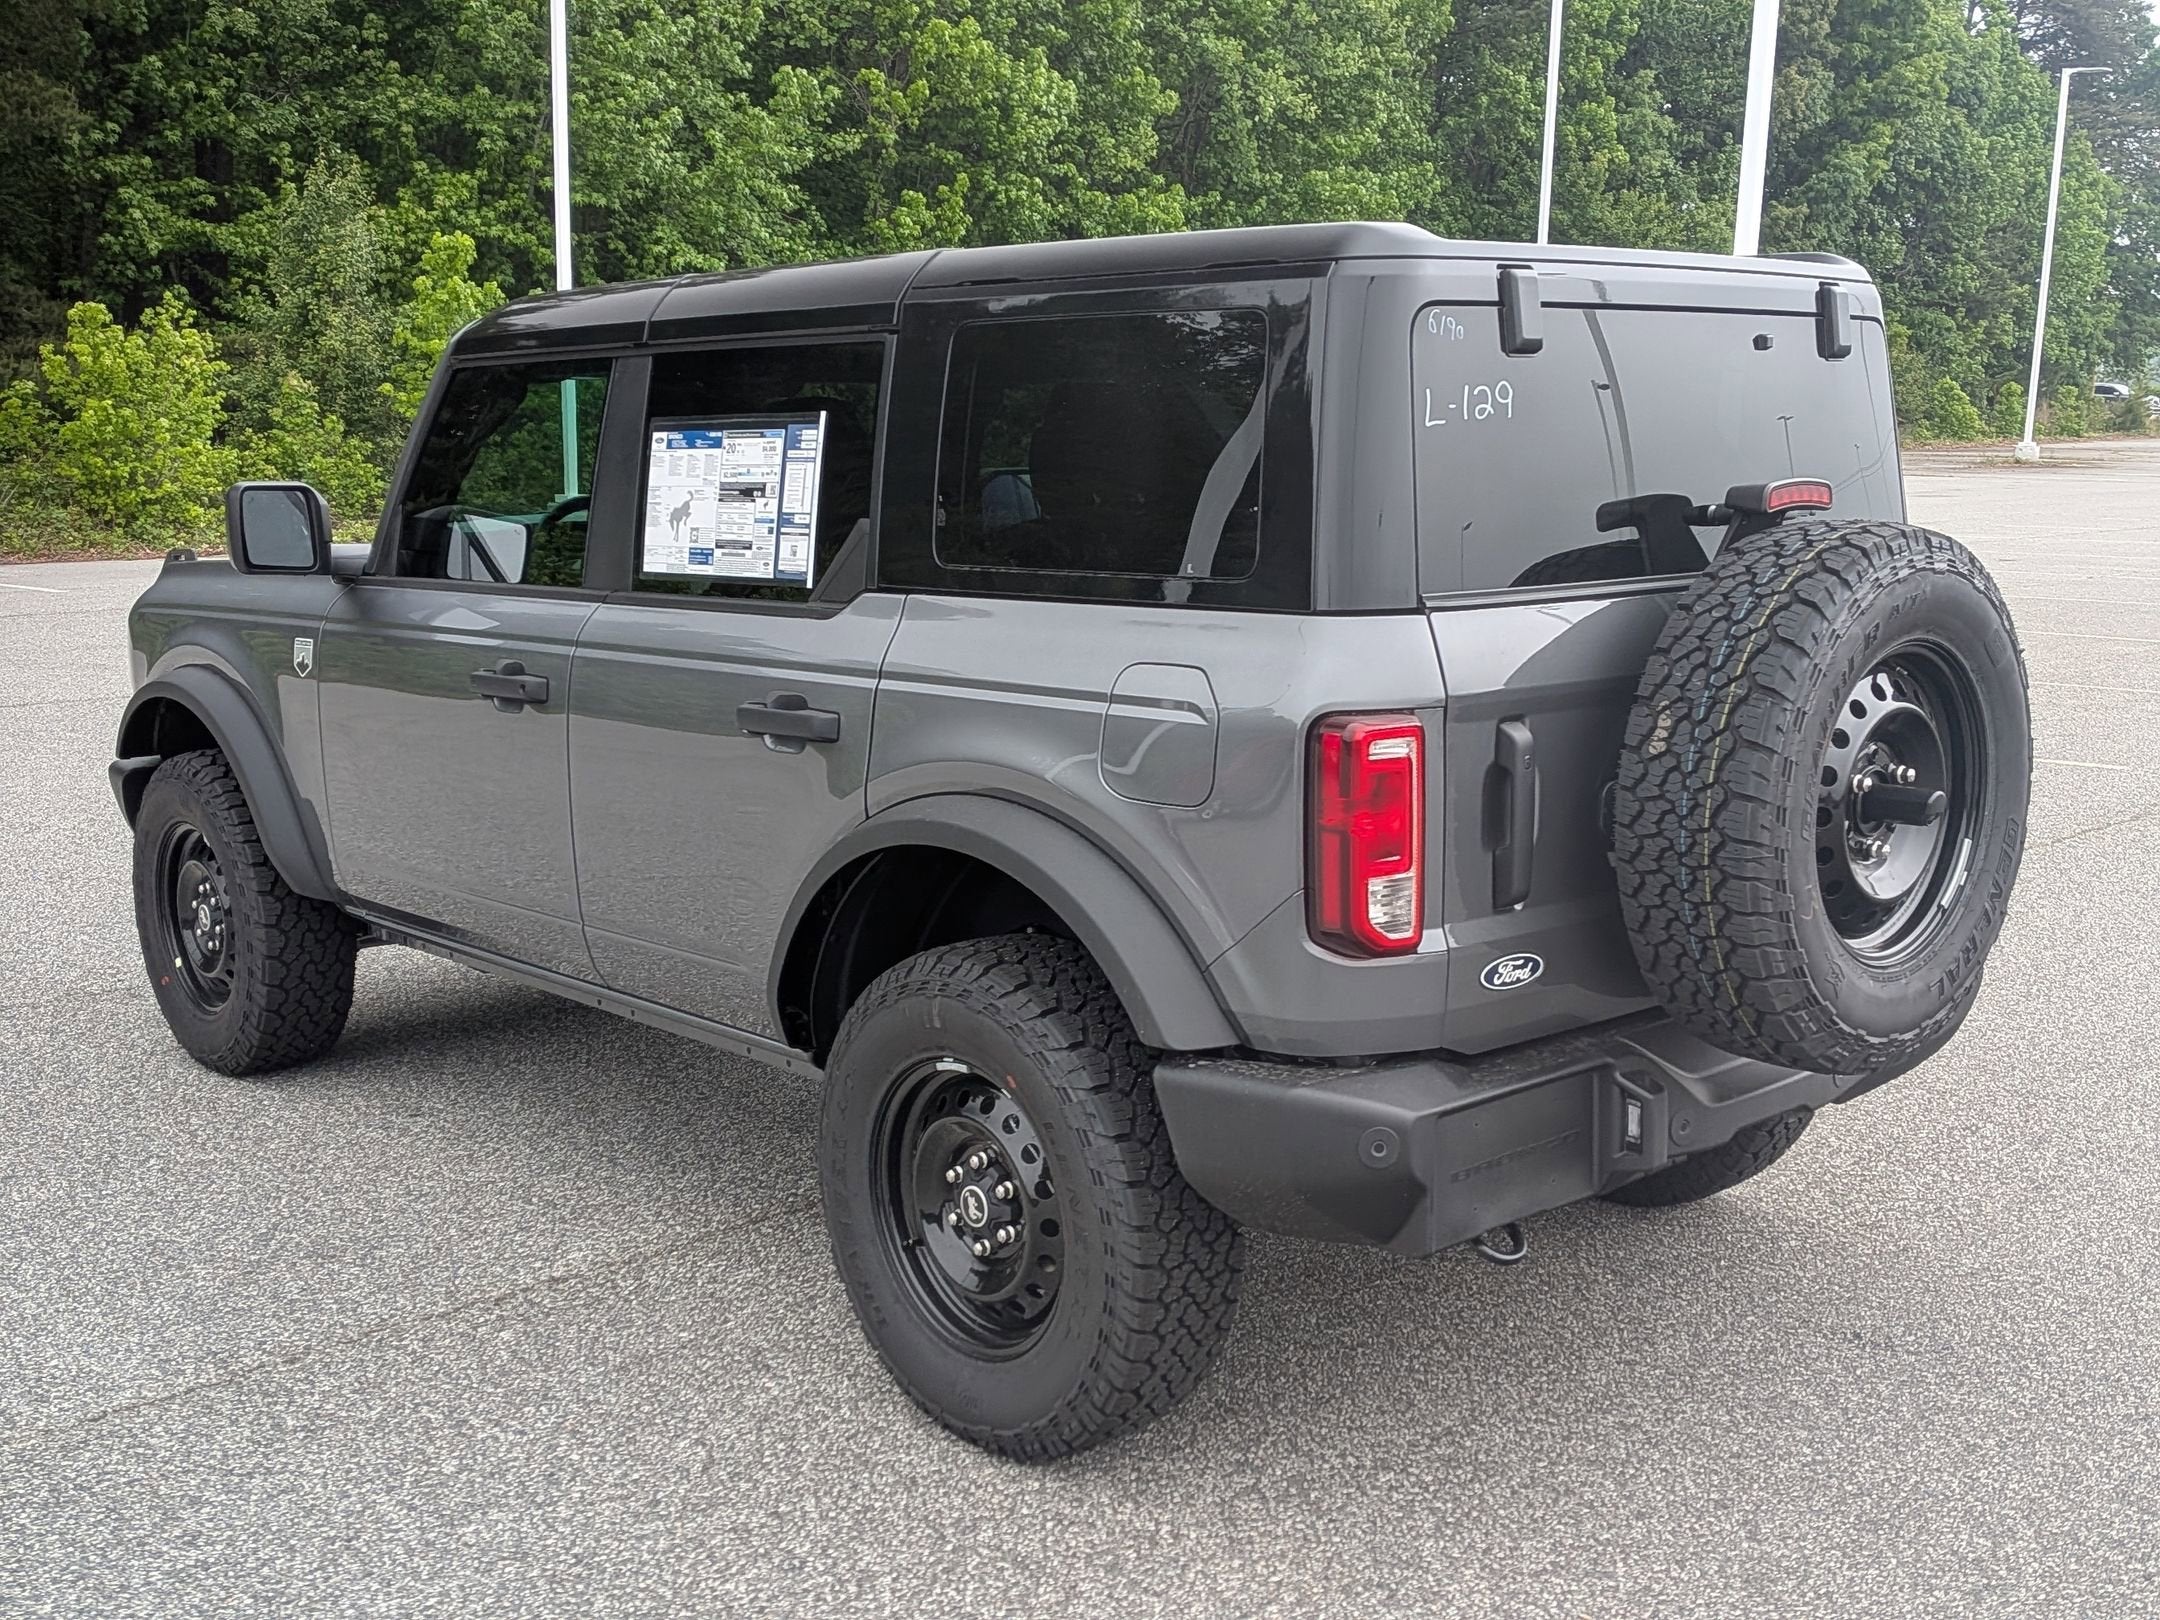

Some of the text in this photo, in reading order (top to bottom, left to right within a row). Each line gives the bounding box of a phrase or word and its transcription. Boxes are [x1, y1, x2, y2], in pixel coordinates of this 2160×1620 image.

[1424, 380, 1513, 428] L-129
[725, 442, 736, 454] 20
[1928, 816, 2020, 1001] GENERAL
[1492, 958, 1534, 986] Ford
